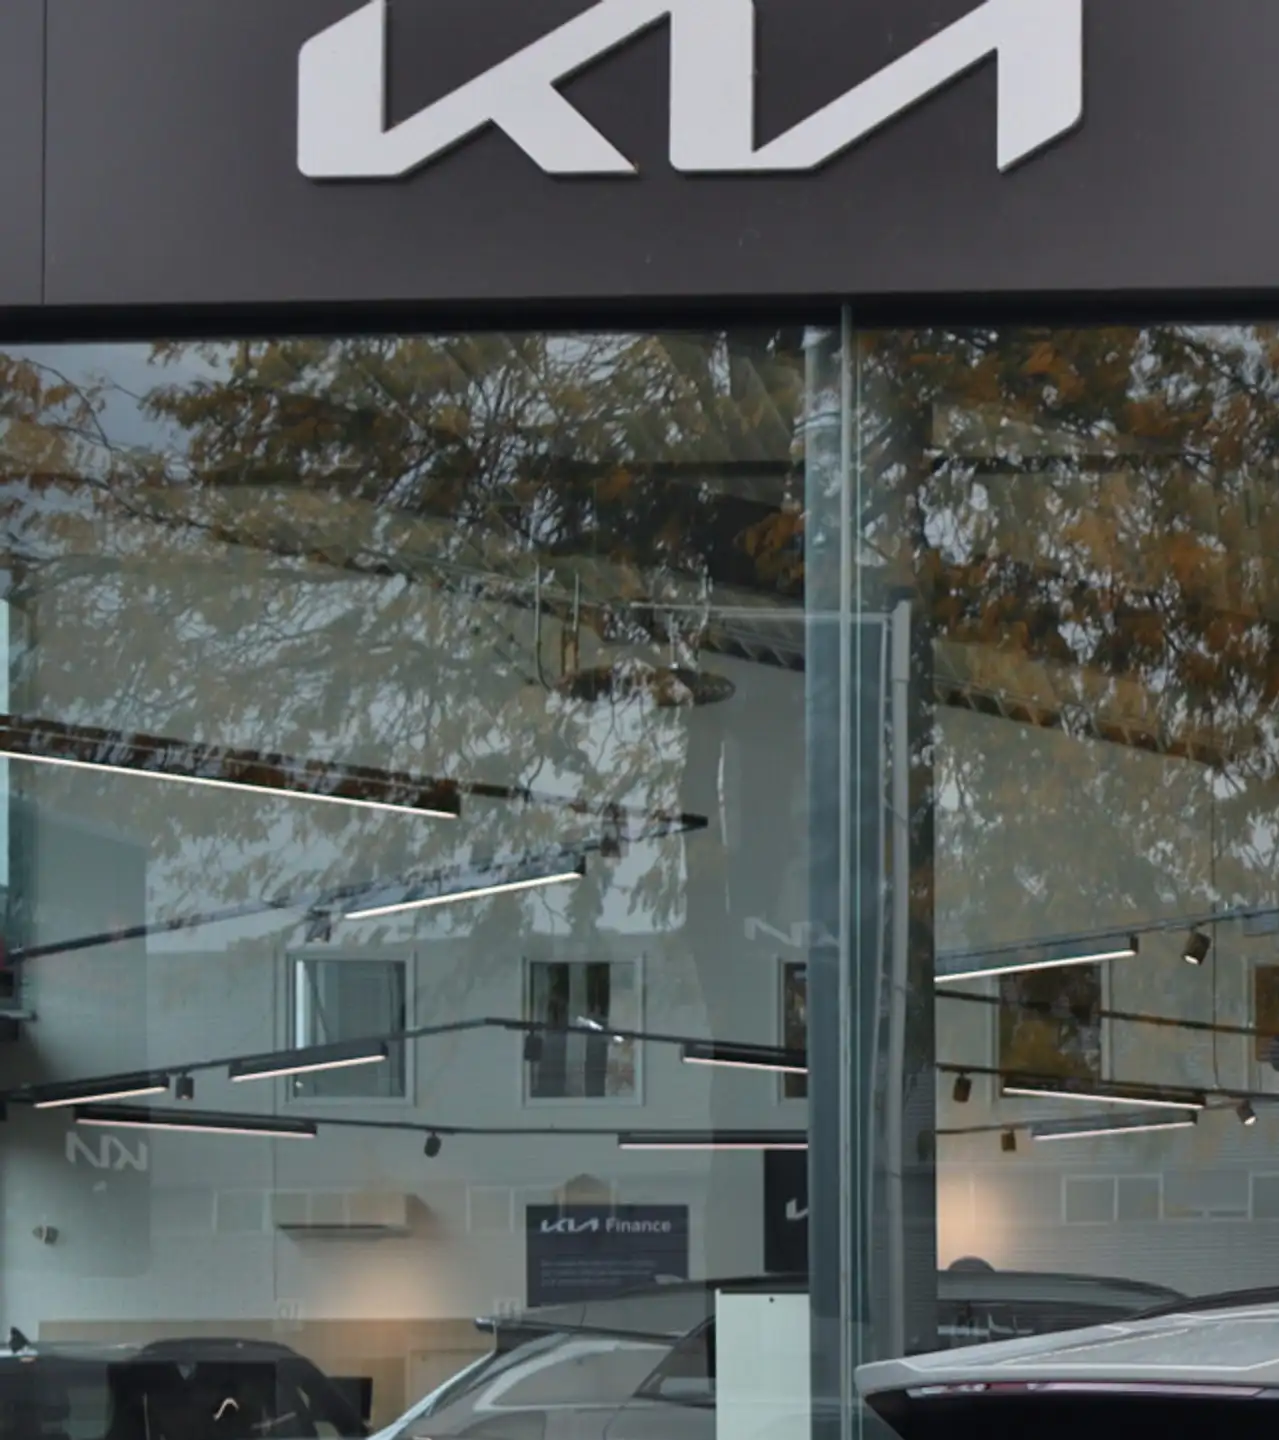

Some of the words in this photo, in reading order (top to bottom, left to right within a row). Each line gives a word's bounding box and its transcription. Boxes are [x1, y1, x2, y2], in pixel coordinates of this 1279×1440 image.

[297, 0, 1083, 177] KIA
[540, 1217, 599, 1232] KIA
[606, 1217, 671, 1232] Finance
